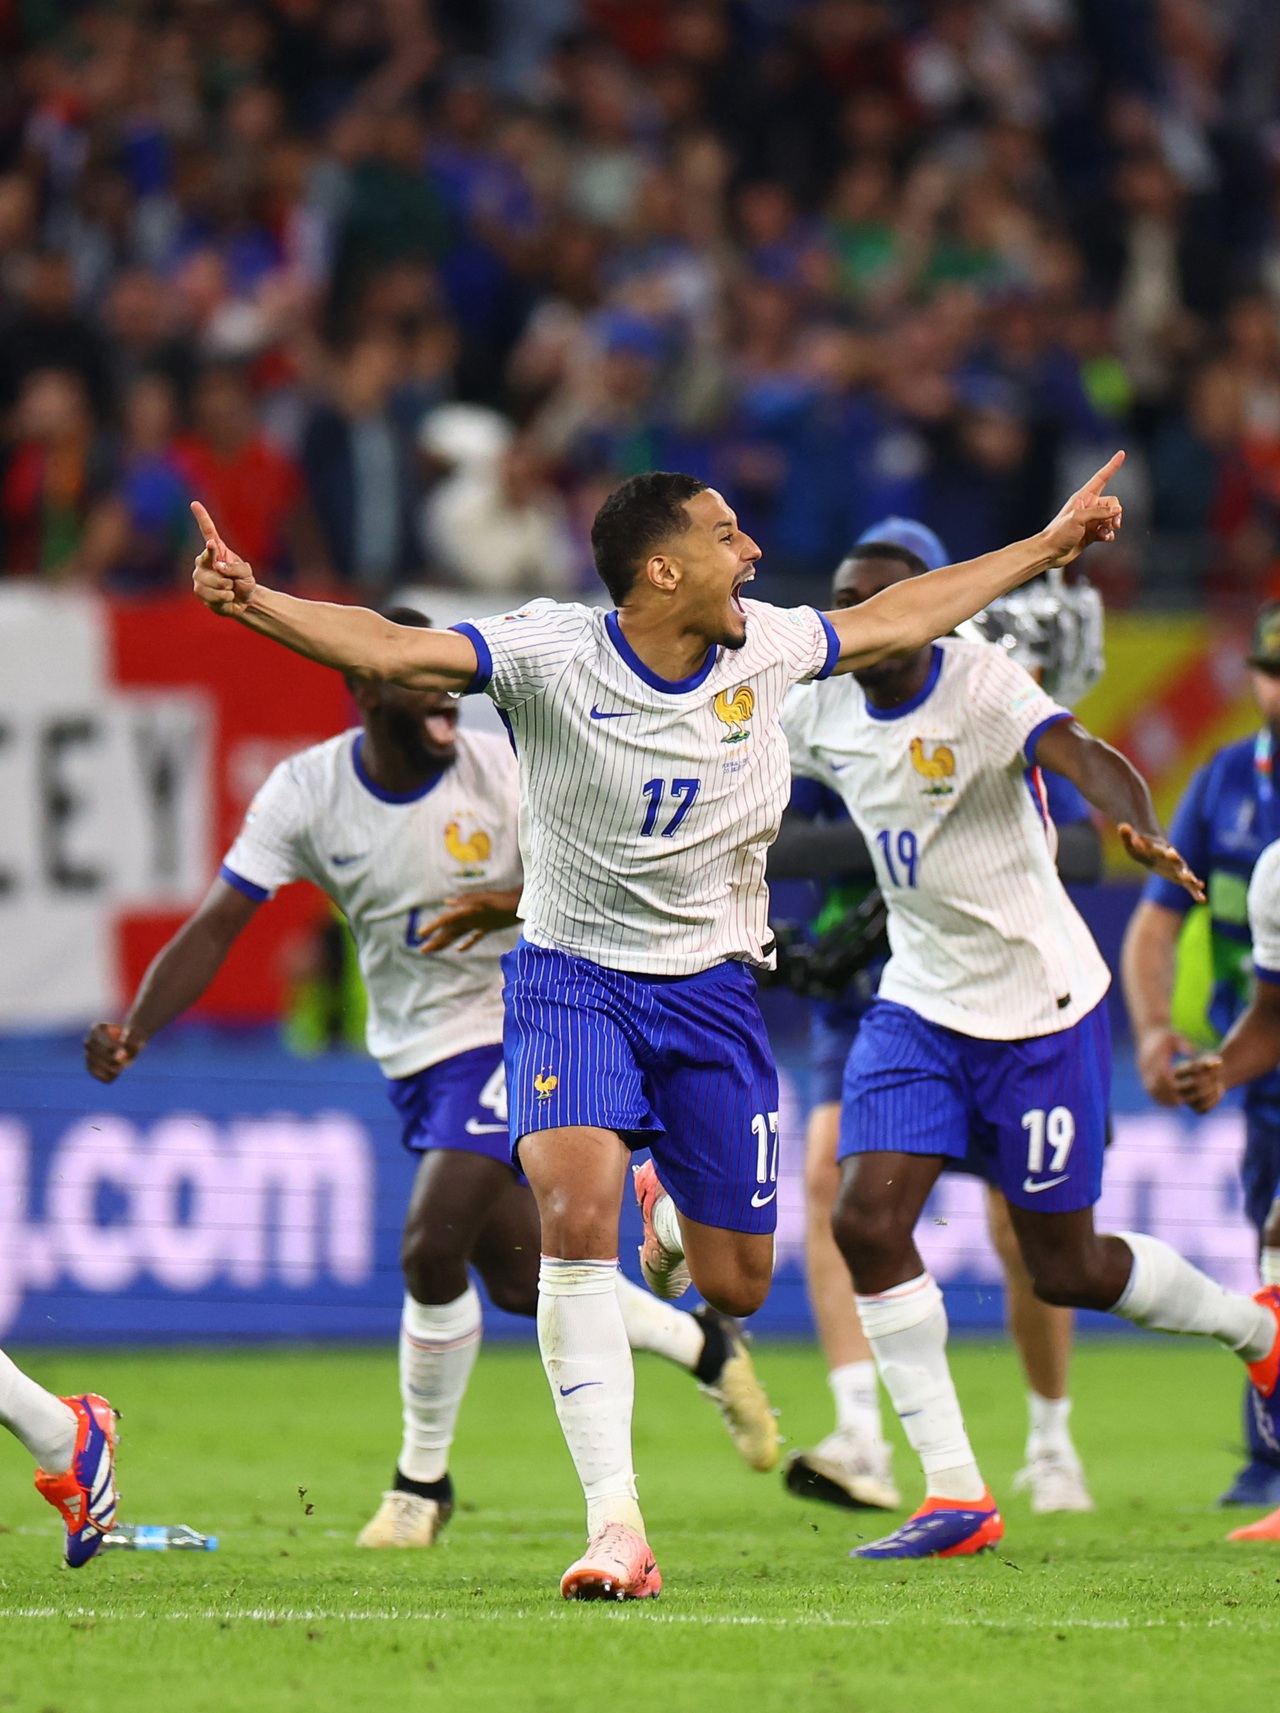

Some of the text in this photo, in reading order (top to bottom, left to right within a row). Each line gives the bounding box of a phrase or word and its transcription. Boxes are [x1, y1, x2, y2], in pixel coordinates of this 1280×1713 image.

[0, 712, 200, 894] EY
[640, 778, 701, 838] 17
[876, 829, 918, 889] 19
[1021, 1105, 1076, 1174] 19
